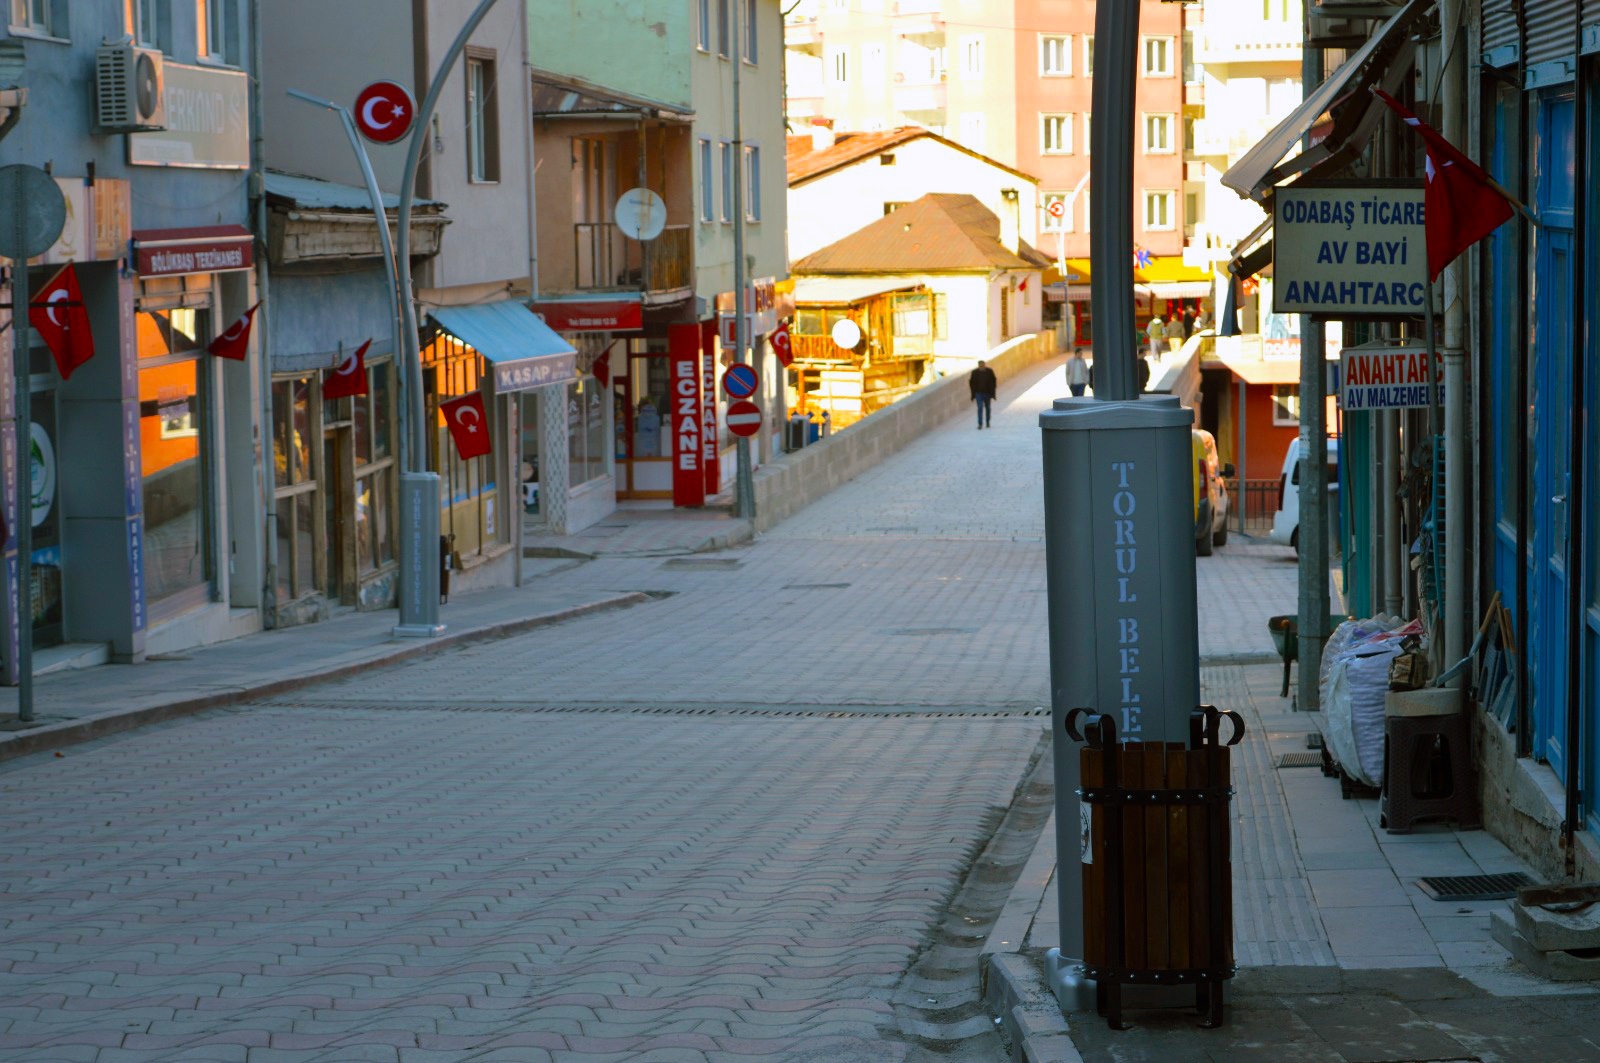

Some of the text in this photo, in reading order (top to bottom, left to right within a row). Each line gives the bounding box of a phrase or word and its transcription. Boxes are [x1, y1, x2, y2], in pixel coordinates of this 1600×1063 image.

[1282, 196, 1425, 230] ODABAŞ TİCARE
[1317, 236, 1407, 265] AV BAYİ
[1284, 281, 1425, 306] ANAHTARC
[501, 365, 551, 386] KASAP
[1346, 352, 1444, 385] ANAHTARC
[703, 355, 715, 460] ECZANE
[1348, 388, 1364, 408] AV
[677, 361, 698, 470] ECZANE
[1111, 461, 1142, 743] TORUL BELE
